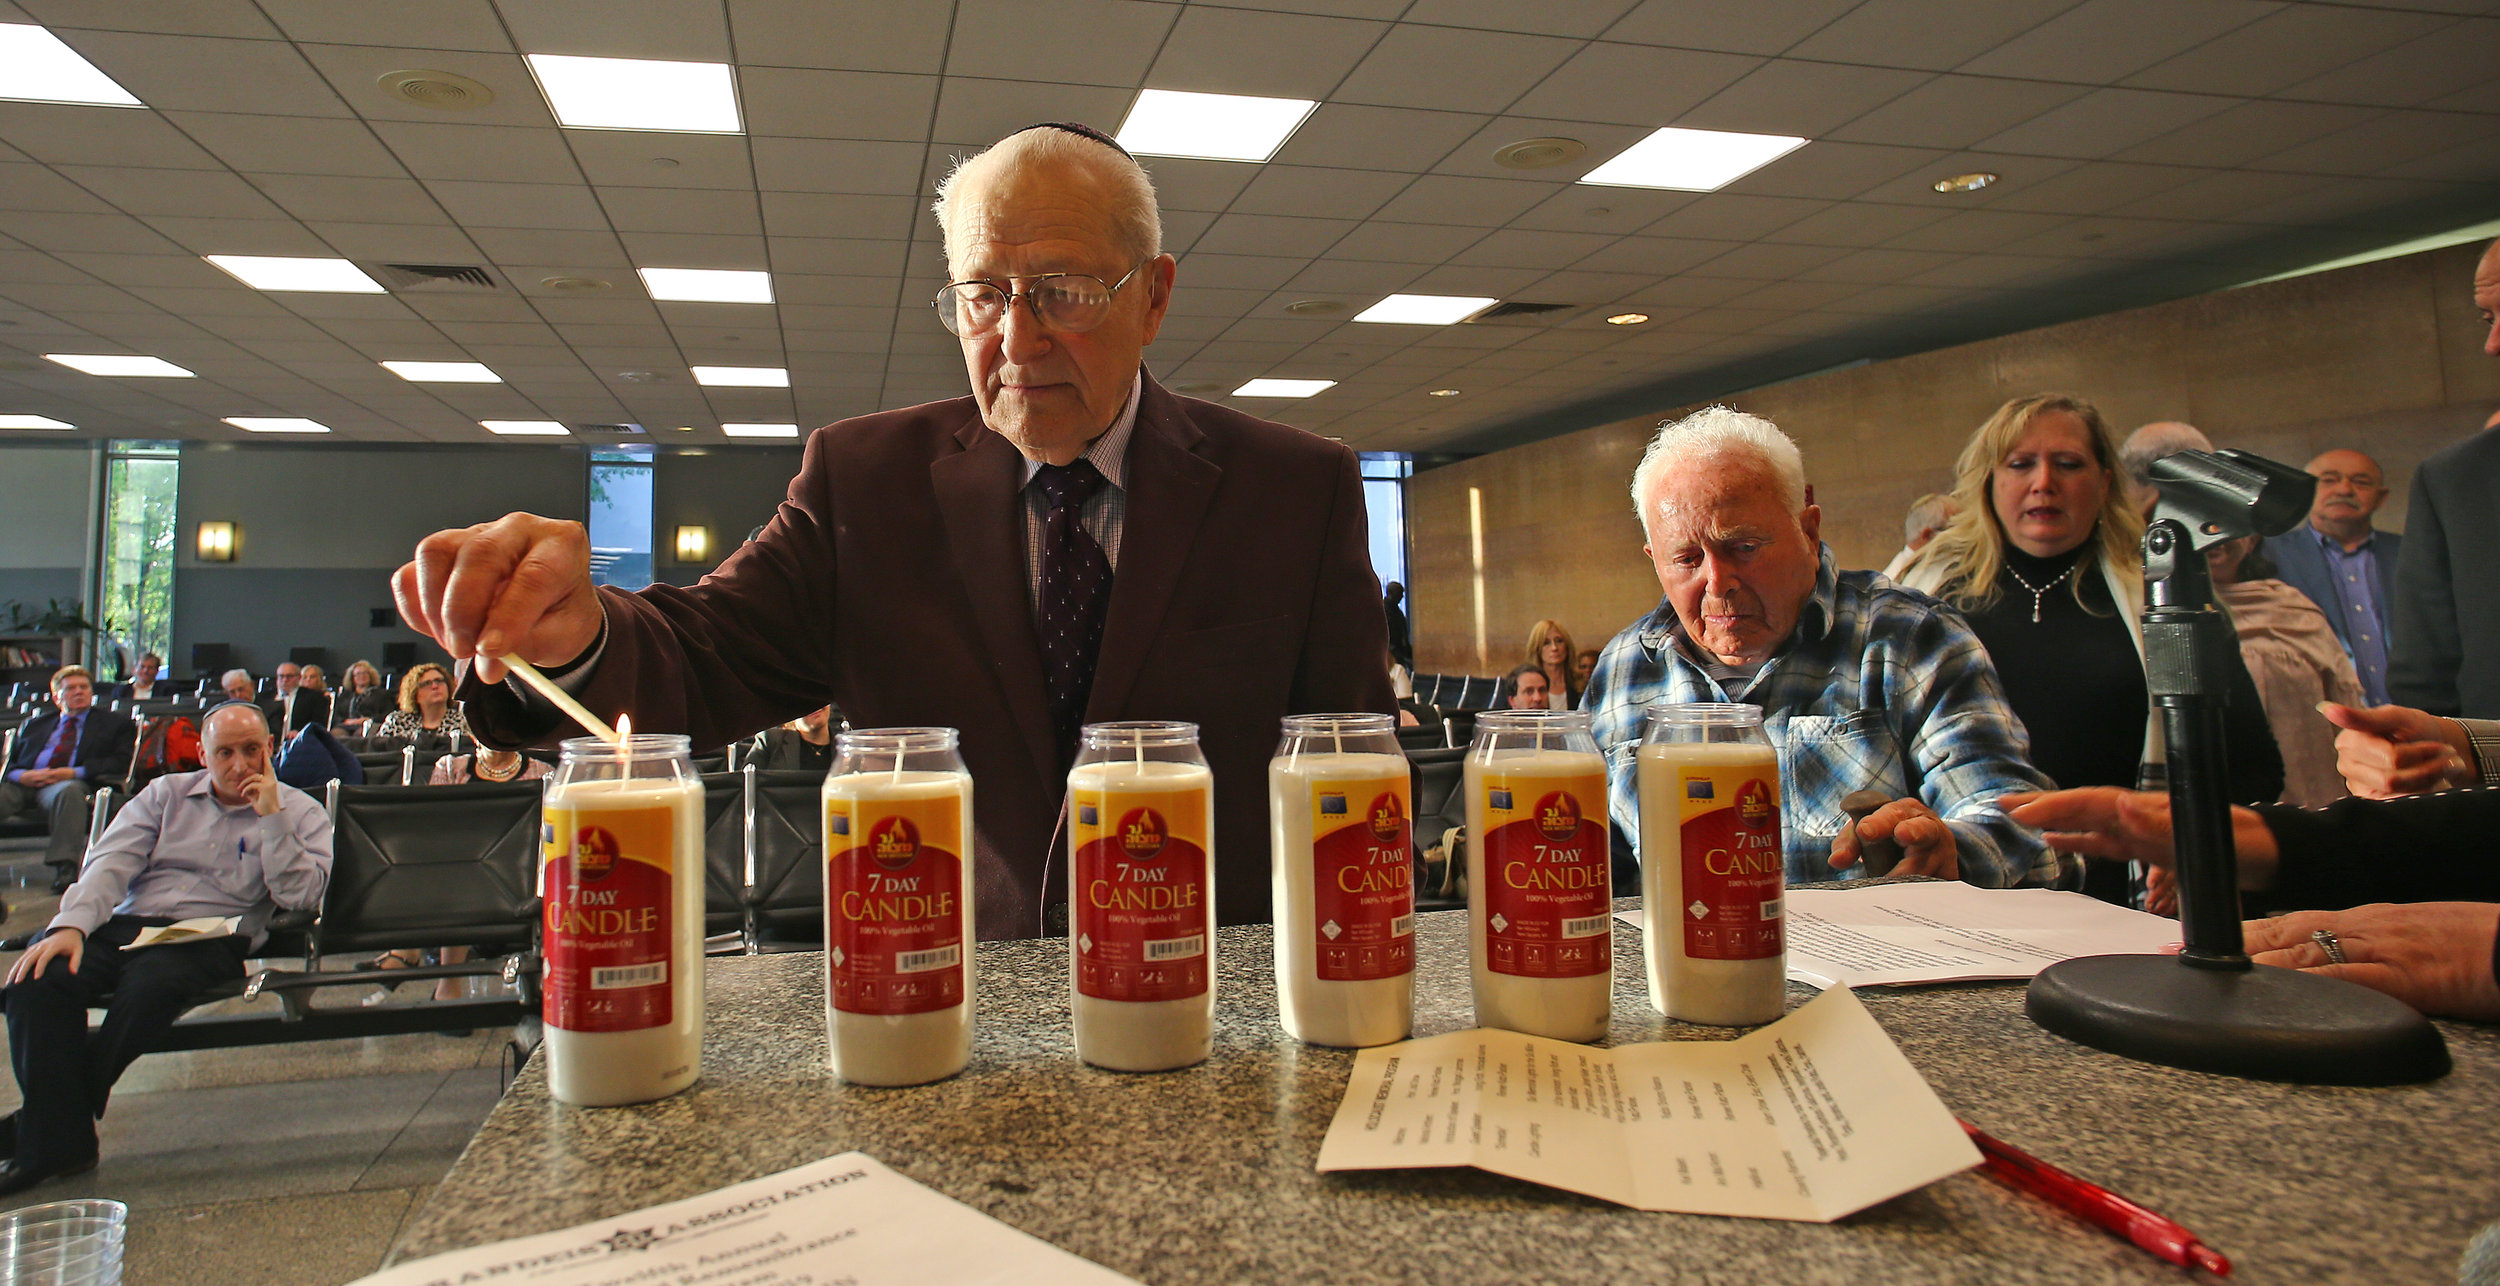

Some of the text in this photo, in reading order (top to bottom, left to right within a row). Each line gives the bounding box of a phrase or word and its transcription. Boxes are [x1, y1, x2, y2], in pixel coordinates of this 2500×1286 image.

[1735, 832, 1773, 849] 7 DAY
[1367, 847, 1404, 866] 7 DAY
[1533, 845, 1583, 863] 7 DAY
[1705, 848, 1783, 875] CANDL
[868, 873, 921, 893] 7 DAY
[1116, 863, 1168, 883] 7 DAY
[1337, 864, 1412, 894] CANDL
[1504, 861, 1606, 890] CANDLE
[567, 884, 619, 905] 7 DAY
[1089, 879, 1198, 910] CANDLE
[1526, 894, 1548, 903] 100%
[1549, 894, 1582, 904] Vegetable
[841, 890, 954, 921] CANDLE
[547, 902, 658, 935] CANDLE
[1108, 912, 1181, 925] 100% Vegetable Oil
[859, 924, 935, 937] 100% Vegetable Oil
[578, 940, 619, 951] Vegetable
[619, 938, 635, 949] Oil
[667, 1169, 868, 1234] ASSOCIATION
[697, 1232, 787, 1265] Annual
